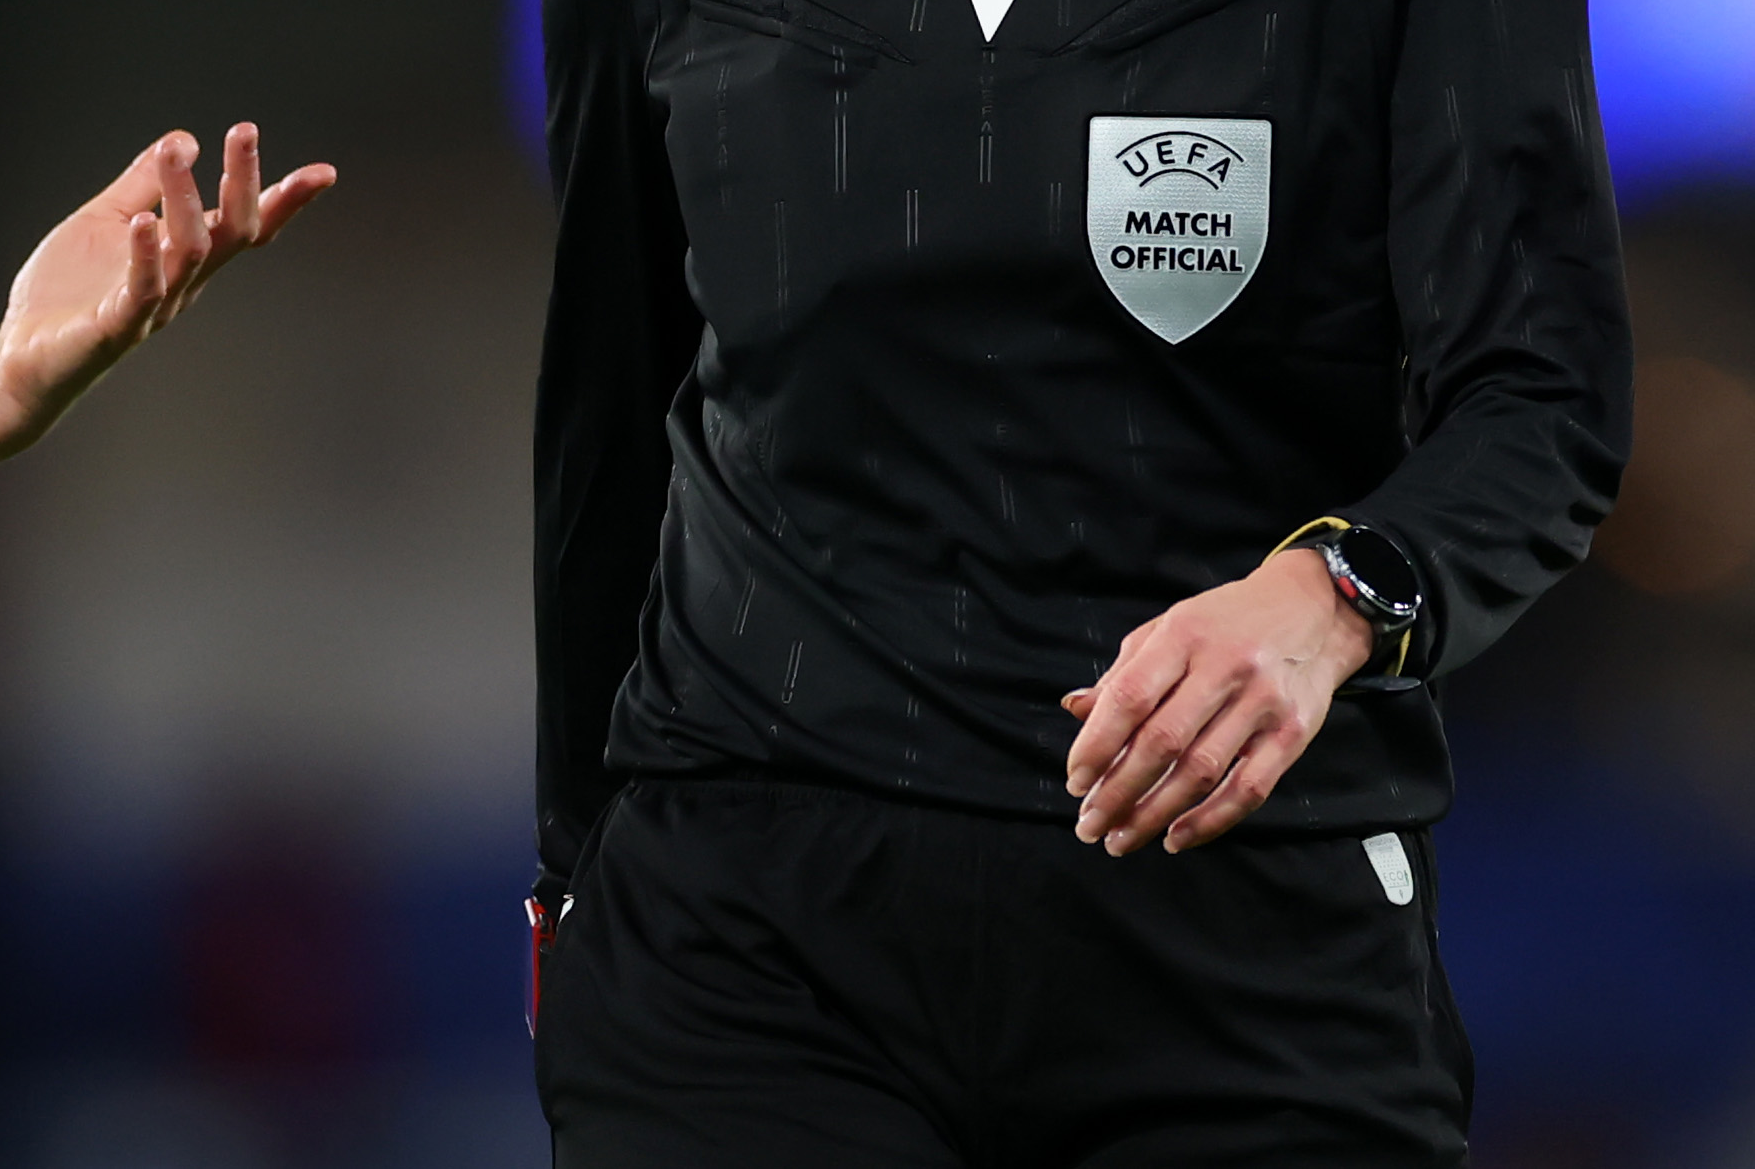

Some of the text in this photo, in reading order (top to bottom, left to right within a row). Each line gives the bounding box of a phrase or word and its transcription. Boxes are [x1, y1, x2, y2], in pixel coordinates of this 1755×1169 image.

[1122, 139, 1232, 183] UEFA
[1124, 211, 1232, 237] MATCH
[1110, 245, 1243, 272] OFFICIAL
